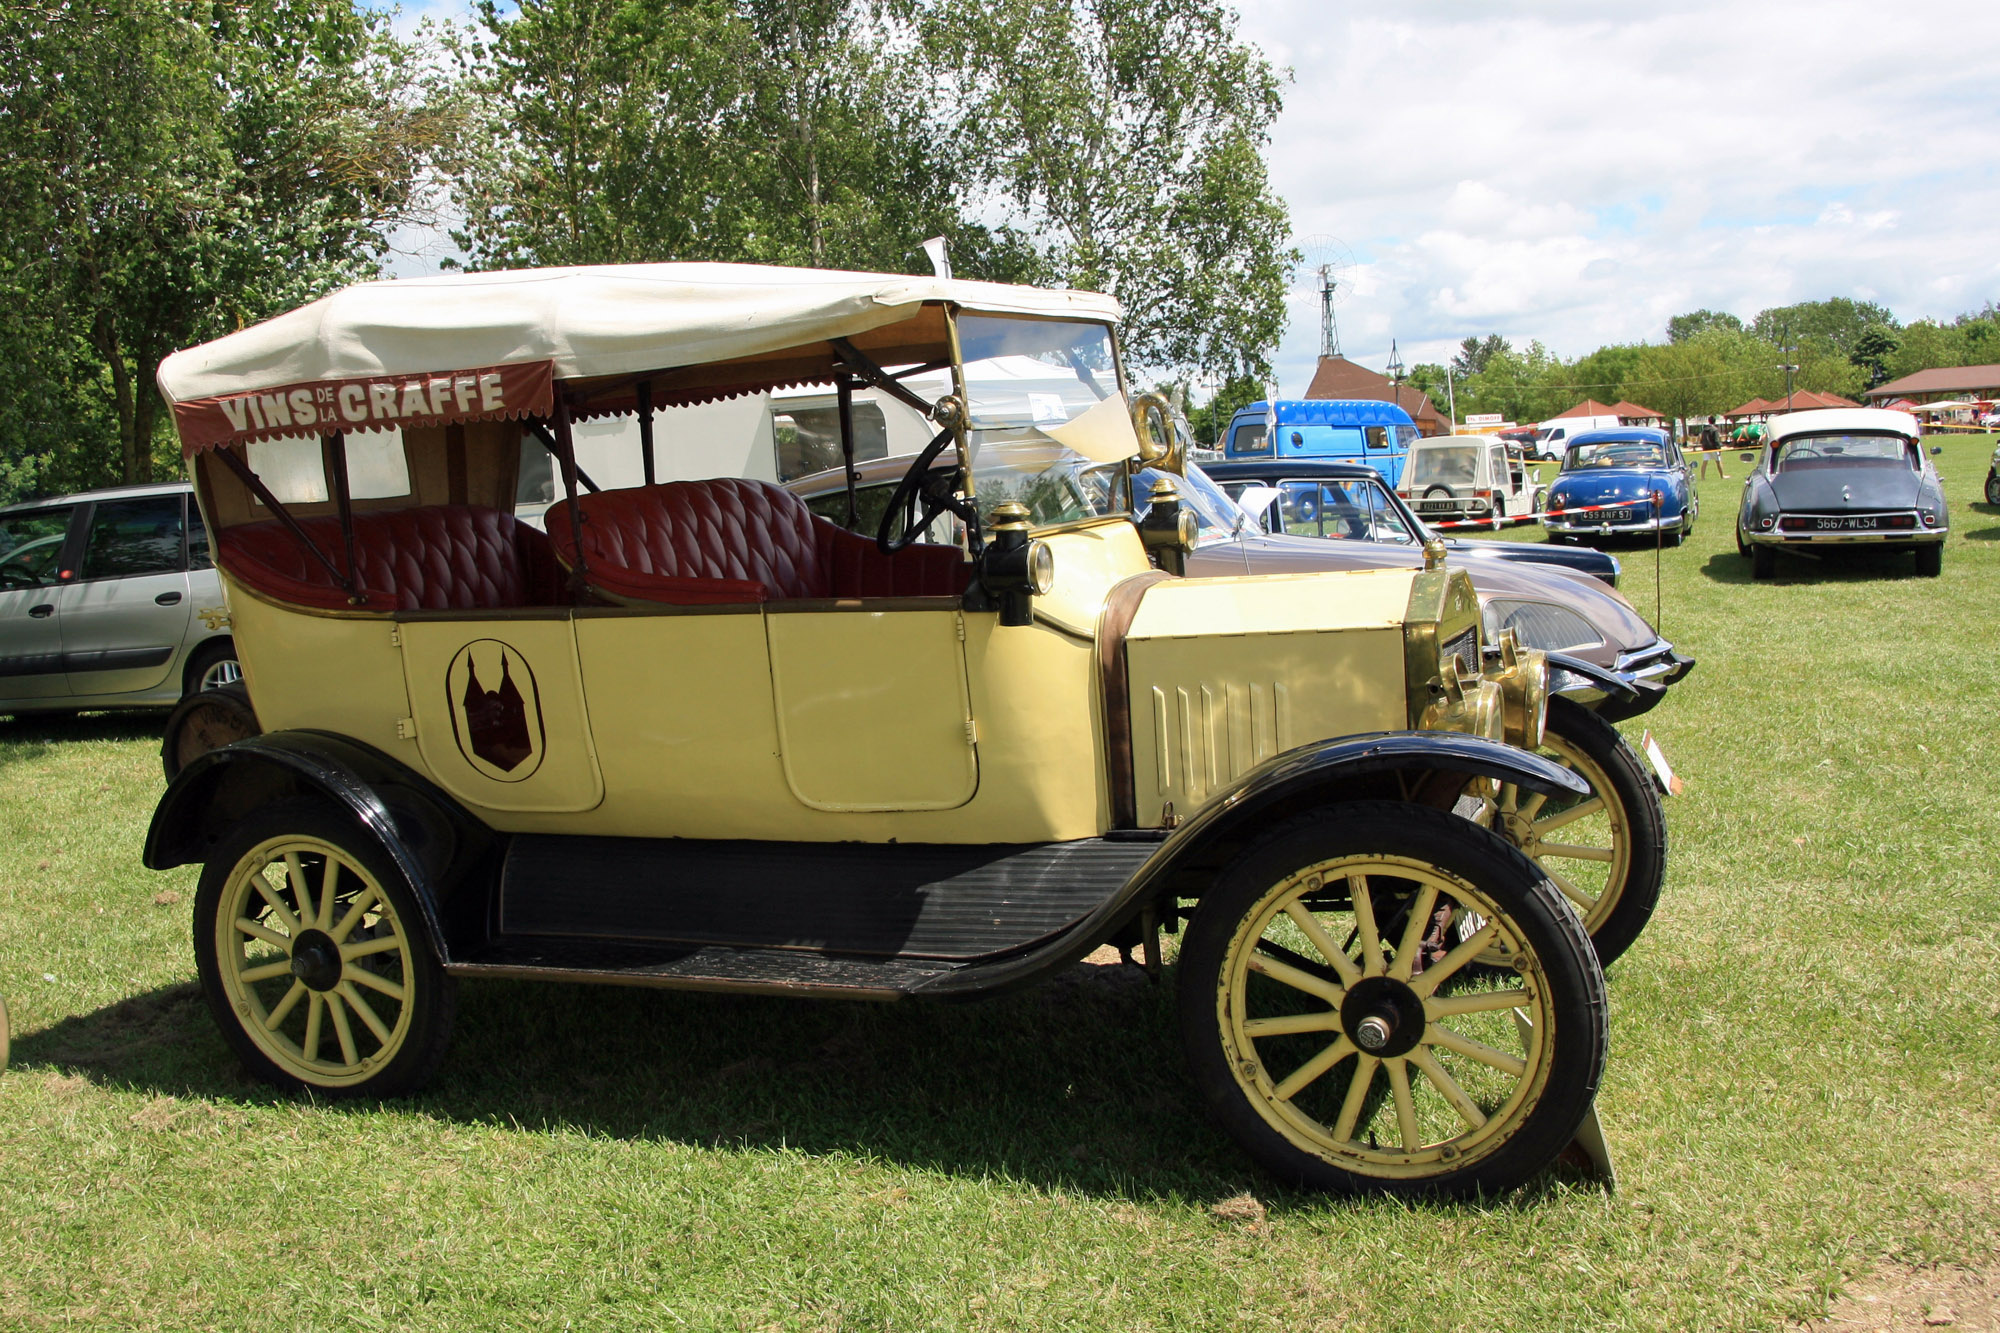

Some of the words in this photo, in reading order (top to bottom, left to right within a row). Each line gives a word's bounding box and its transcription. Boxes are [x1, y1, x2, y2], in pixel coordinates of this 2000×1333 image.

[316, 387, 334, 403] DE
[338, 374, 506, 422] CRAFFE
[218, 389, 317, 432] VINS
[320, 407, 338, 422] LA
[1618, 510, 1629, 519] 57
